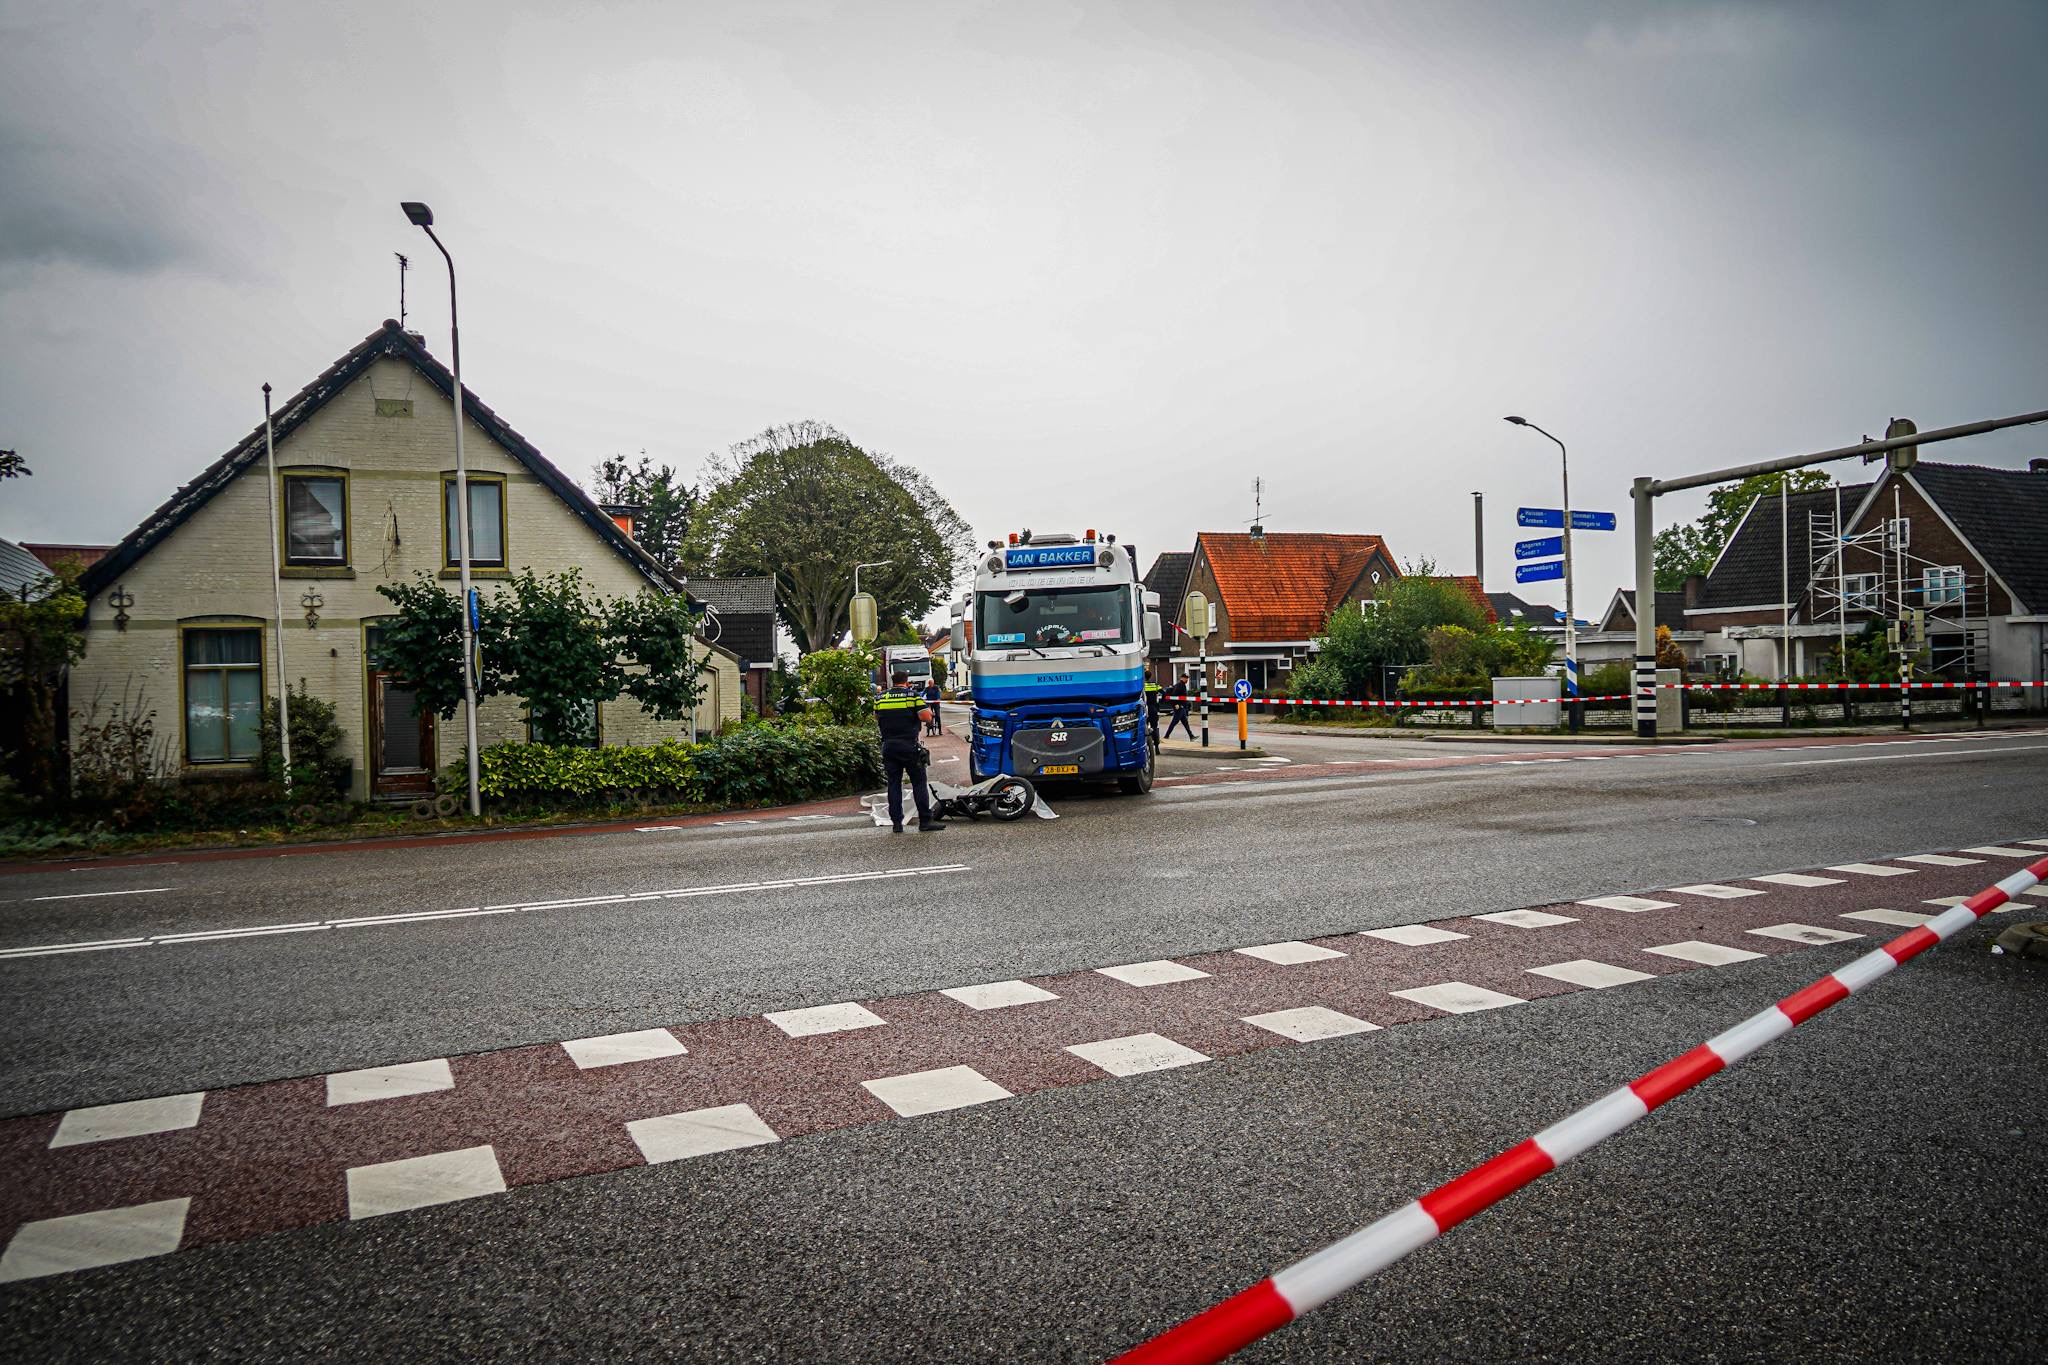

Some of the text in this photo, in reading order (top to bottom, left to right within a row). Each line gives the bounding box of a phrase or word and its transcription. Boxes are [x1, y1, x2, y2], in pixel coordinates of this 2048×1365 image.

[1521, 541, 1541, 549] Angeren
[1008, 551, 1091, 566] JAN BAKKER
[1521, 563, 1554, 573] Doornenburg
[1008, 576, 1096, 588] OLDEBROEK
[1036, 674, 1074, 684] RENAULT
[1050, 731, 1069, 743] SR
